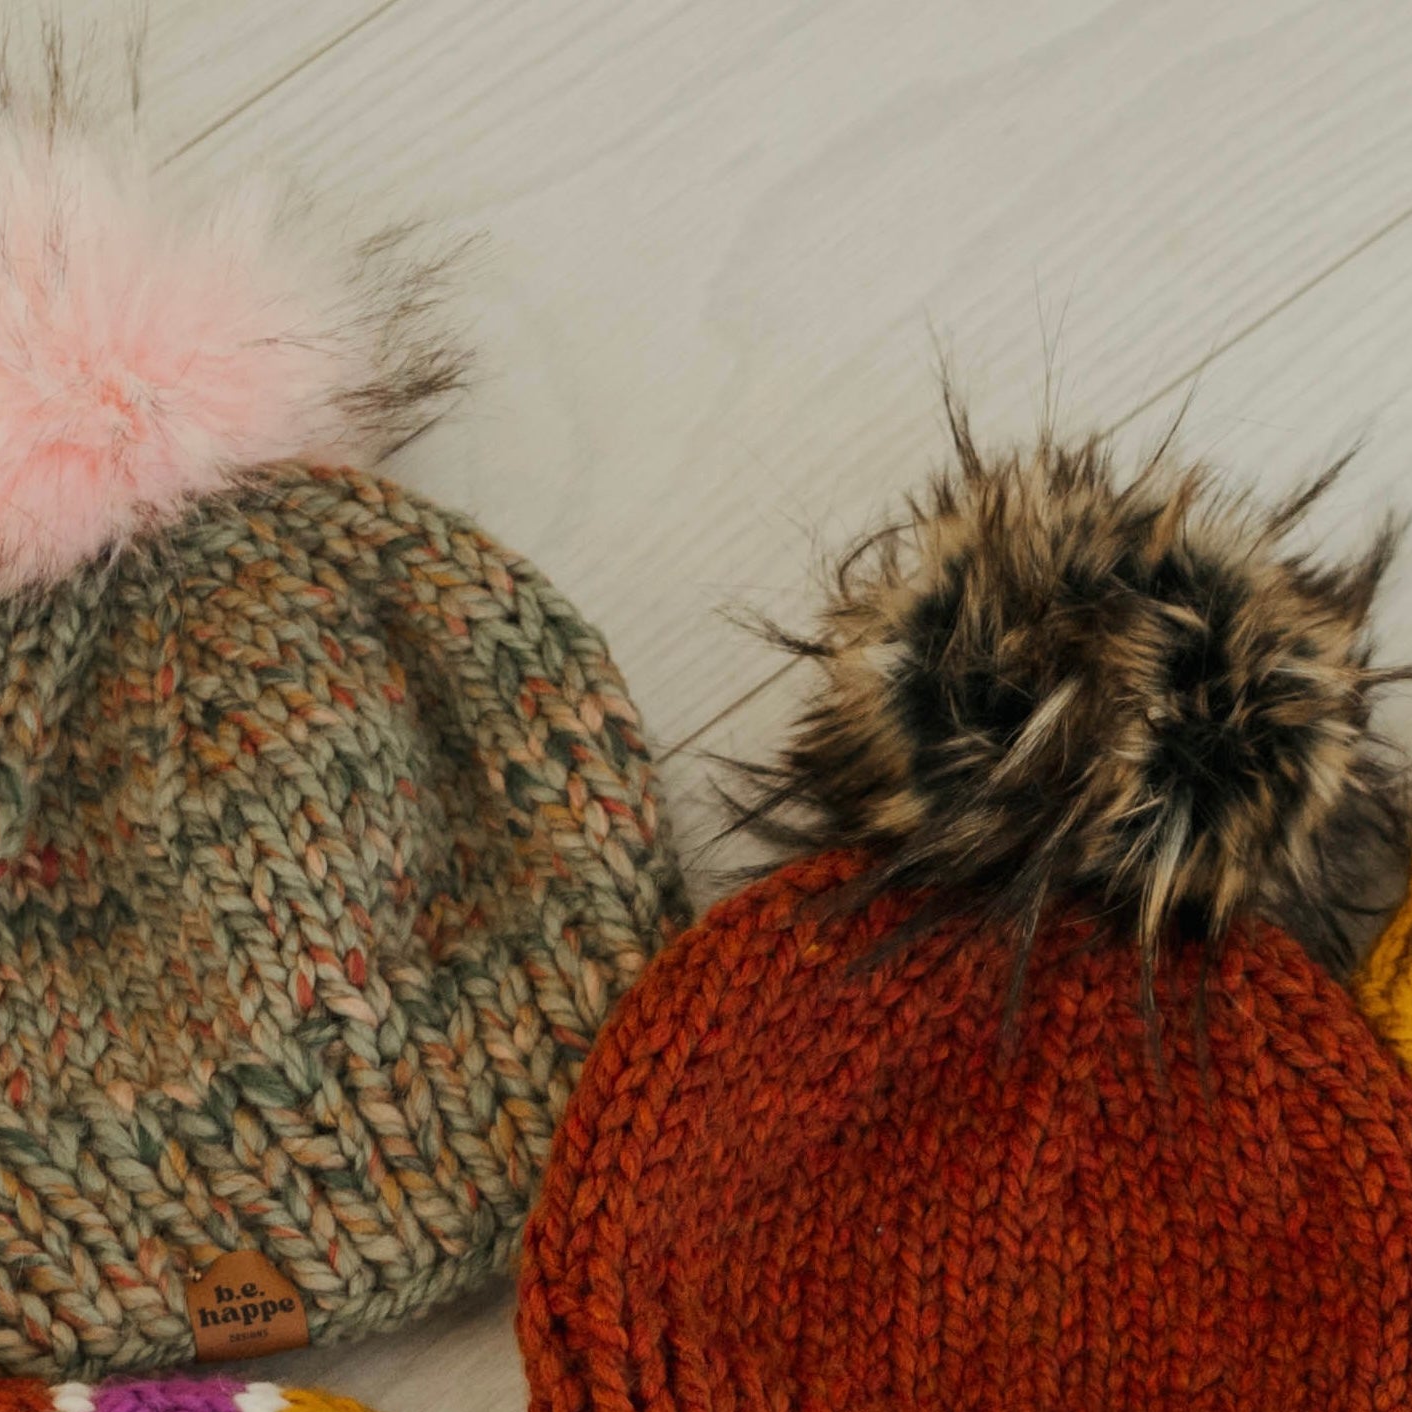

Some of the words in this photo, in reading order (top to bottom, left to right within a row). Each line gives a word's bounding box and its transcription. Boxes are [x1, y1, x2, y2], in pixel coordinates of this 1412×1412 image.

[215, 1281, 265, 1304] b.e.
[199, 1297, 296, 1328] happe
[229, 1330, 269, 1344] DESIGNS
